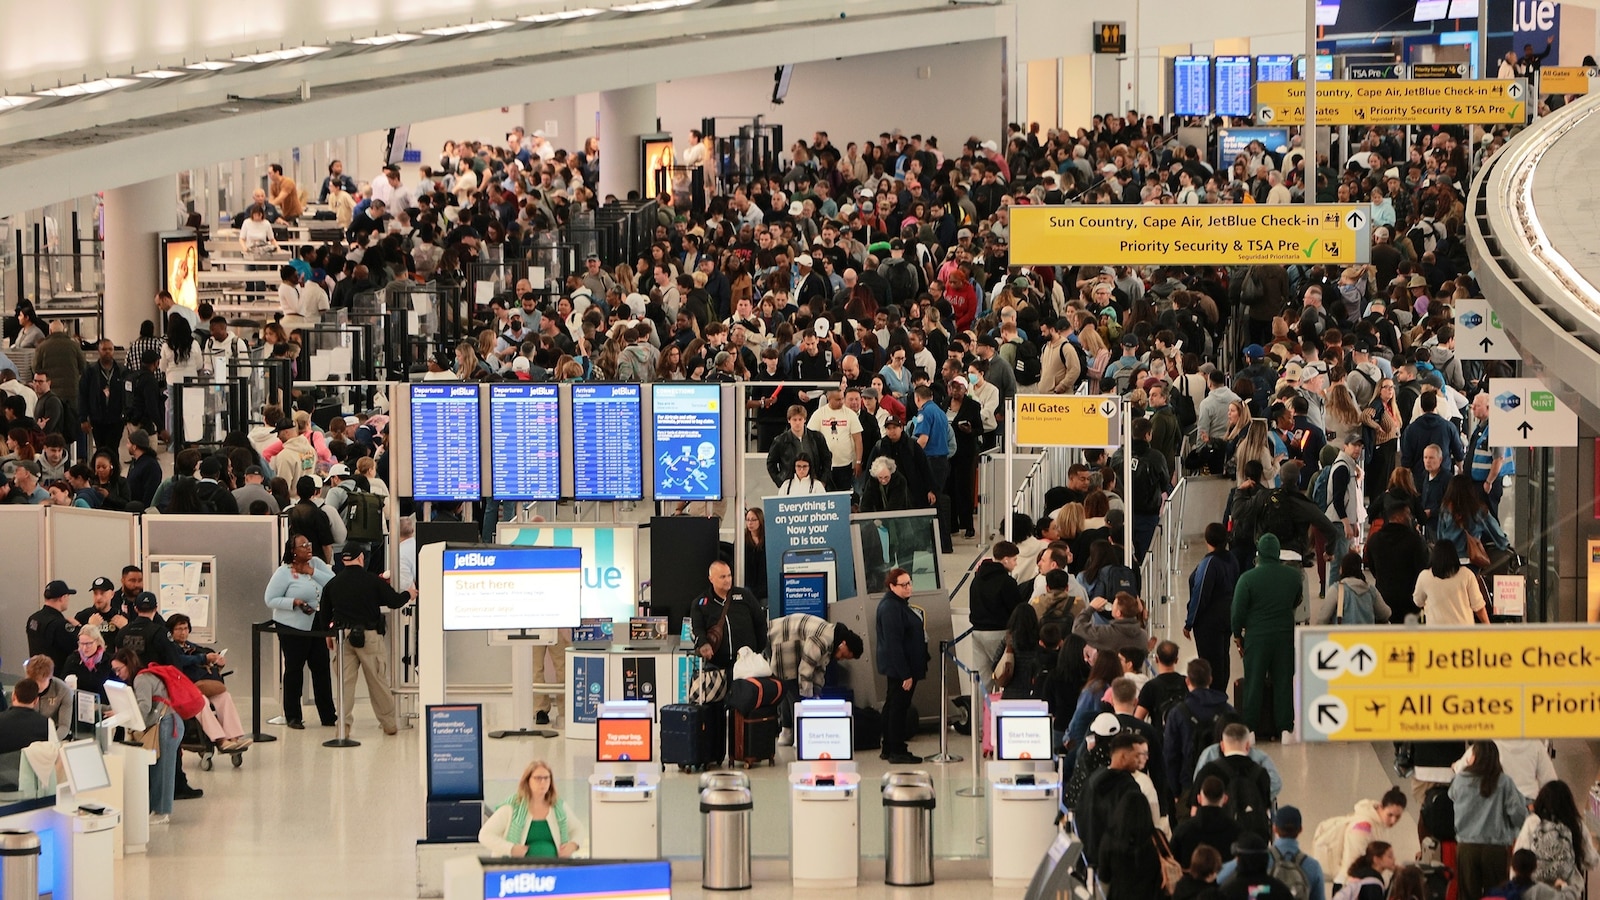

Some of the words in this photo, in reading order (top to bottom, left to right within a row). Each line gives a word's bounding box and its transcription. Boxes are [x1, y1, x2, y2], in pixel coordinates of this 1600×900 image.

[1352, 69, 1367, 78] TSA
[1368, 68, 1381, 77] Pre
[1287, 88, 1306, 98] Sun
[1315, 88, 1353, 99] ountry,
[1357, 87, 1382, 98] Cape
[1385, 87, 1402, 97] Air,
[1404, 87, 1441, 97] JetBlue
[1443, 86, 1488, 96] Check-in
[1294, 106, 1305, 115] Al
[1315, 106, 1340, 115] ates
[1370, 106, 1405, 117] Priority
[1410, 105, 1451, 116] Security
[1455, 106, 1463, 114] &
[1466, 105, 1486, 114] TSA
[1489, 105, 1505, 114] Pre
[1049, 216, 1074, 228] Sun
[1079, 216, 1138, 230] Country,
[1143, 215, 1177, 229] Cape
[1181, 215, 1203, 229] Air,
[1207, 214, 1257, 227] JetBlue
[1261, 214, 1320, 227] Check-in
[1119, 240, 1170, 254] Priority
[1174, 239, 1228, 253] Security
[1233, 240, 1243, 251] &
[1247, 240, 1274, 251] TSA
[1278, 239, 1300, 251] Pre
[450, 387, 475, 397] jetBlue
[529, 387, 555, 397] jetBlue
[611, 387, 636, 397] jetBlue
[1020, 402, 1036, 413] All
[1038, 402, 1070, 413] Gates
[778, 502, 826, 513] Everything
[827, 501, 835, 510] is
[775, 516, 787, 524] on
[788, 514, 808, 525] your
[810, 512, 839, 524] phone.
[786, 526, 806, 535] Now
[808, 525, 828, 535] your
[790, 537, 800, 546] ID
[801, 536, 809, 545] is
[810, 536, 827, 545] too.
[454, 553, 496, 569] jetBlue
[584, 566, 622, 589] ue
[455, 579, 486, 590] Start
[488, 579, 515, 589] here
[1425, 647, 1512, 669] JetBlue
[1399, 695, 1432, 715] All
[1442, 694, 1513, 715] Gates
[436, 727, 455, 735] under
[463, 727, 473, 735] up!
[1400, 721, 1430, 732] Todas
[1433, 721, 1449, 731] las
[1452, 722, 1495, 733] puertas
[630, 733, 642, 741] bag.
[499, 873, 556, 897] jetBlue
